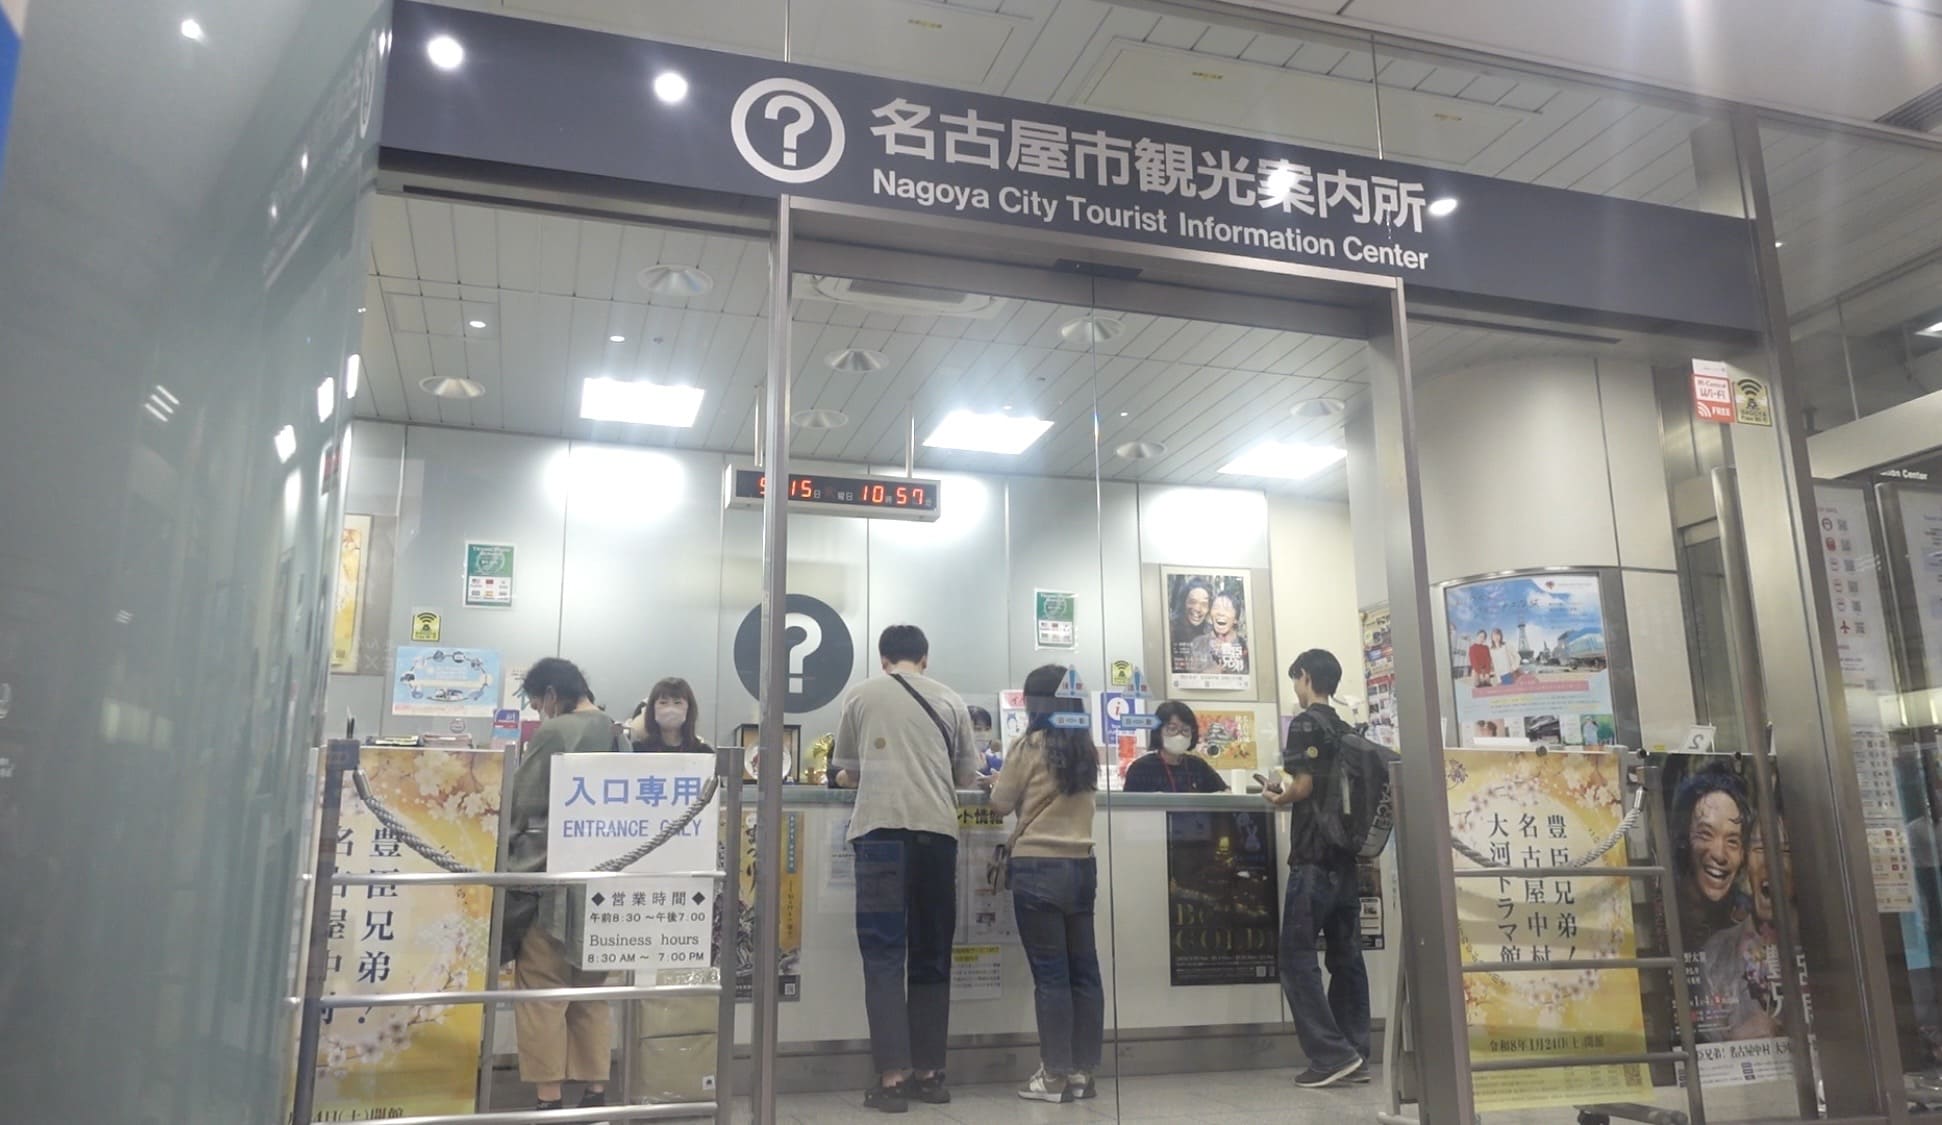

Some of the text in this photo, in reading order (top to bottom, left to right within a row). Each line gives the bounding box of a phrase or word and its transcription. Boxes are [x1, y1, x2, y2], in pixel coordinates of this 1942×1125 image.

[870, 97, 1426, 234] 名古屋市観光案内所
[872, 169, 1430, 271] Nagoya City Tourist Information Center
[564, 775, 702, 808] 入口専用
[563, 819, 649, 838] ENTRANCE
[611, 891, 687, 907] 営業時間
[589, 933, 700, 947] Business hours
[619, 953, 636, 963] AM
[688, 951, 705, 961] PM
